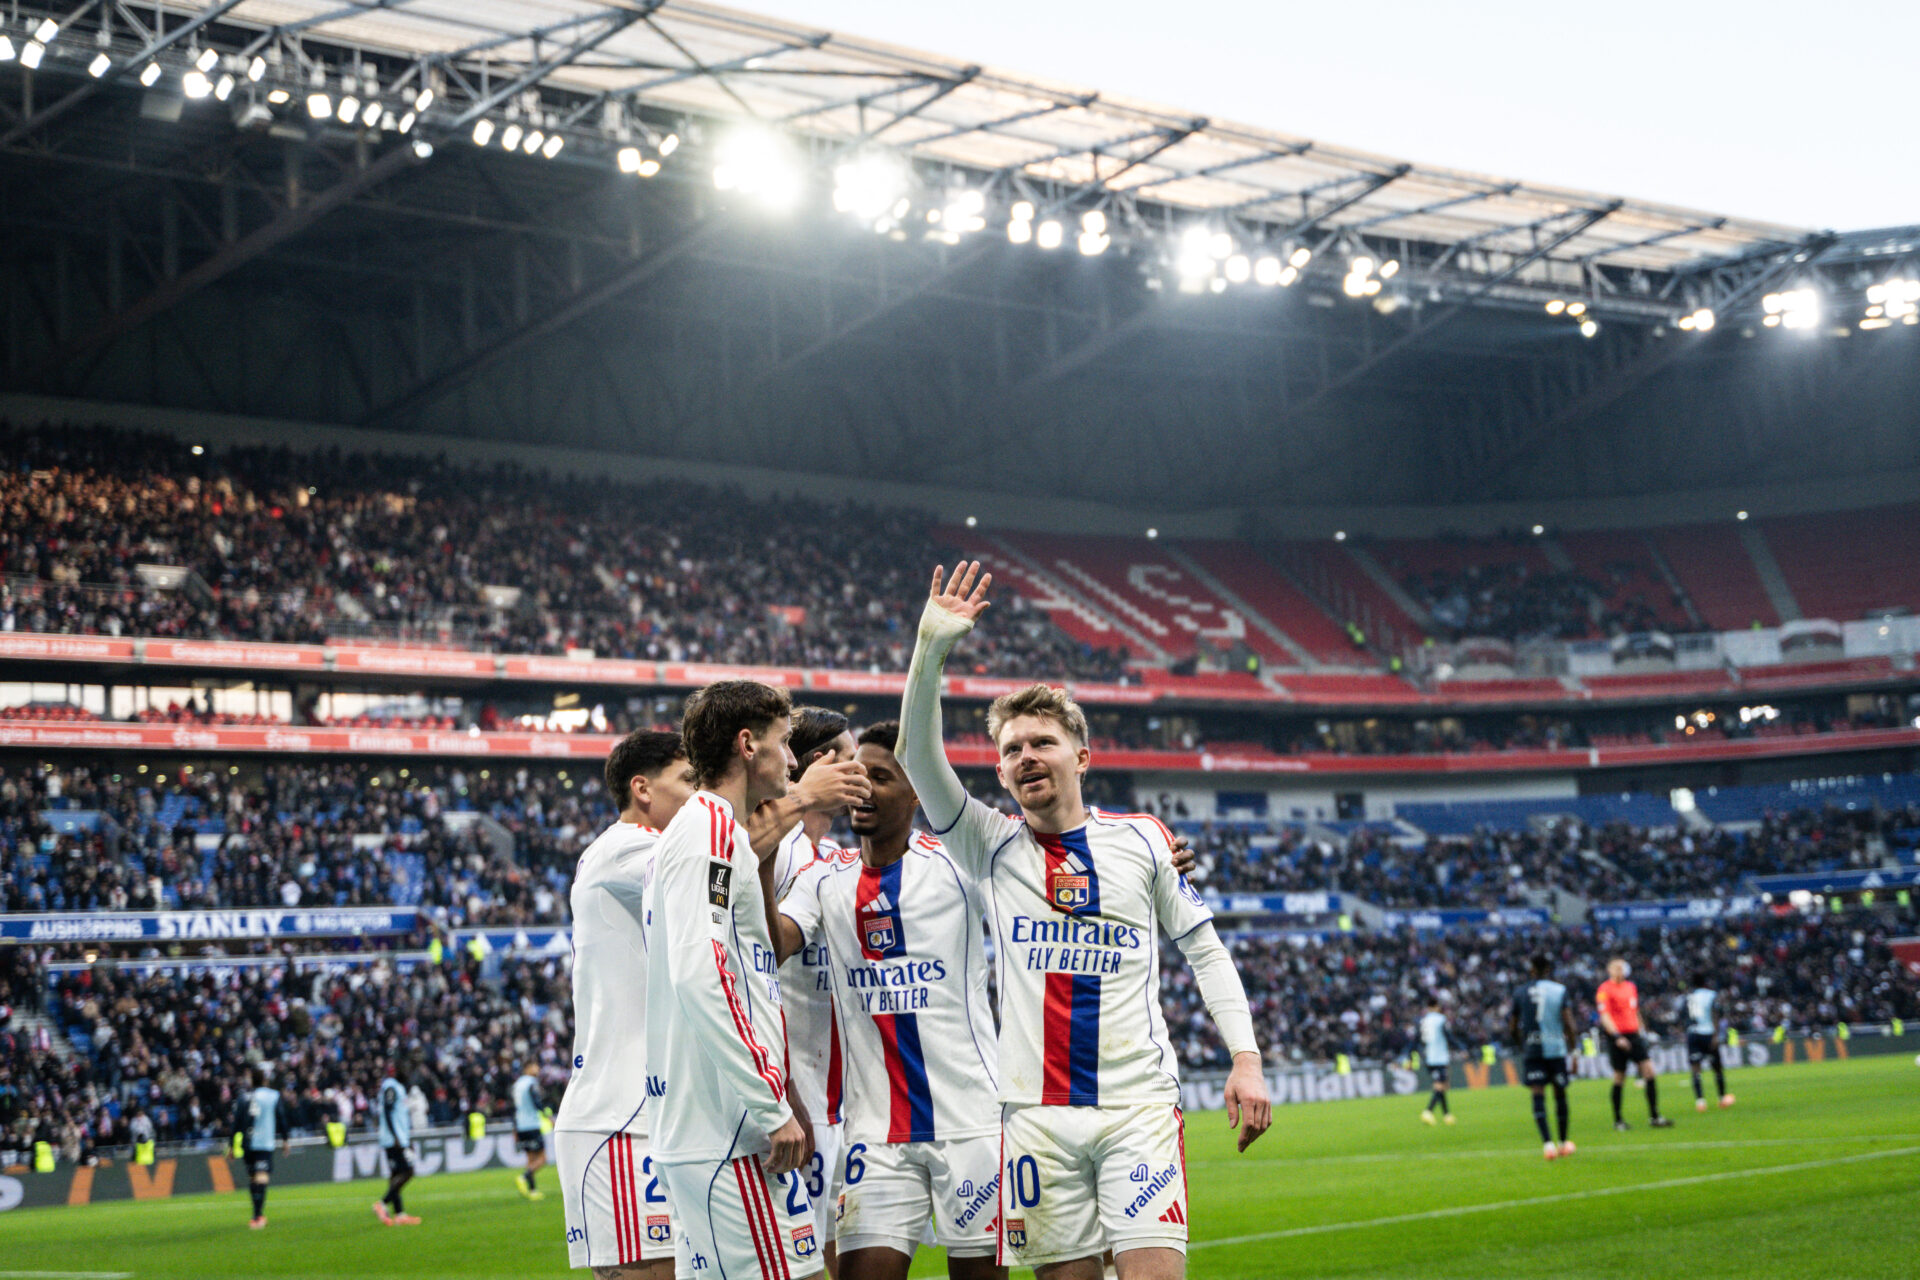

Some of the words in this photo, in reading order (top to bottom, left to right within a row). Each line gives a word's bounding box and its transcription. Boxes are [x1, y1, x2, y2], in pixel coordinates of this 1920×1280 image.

[1059, 888, 1085, 902] OL
[158, 912, 284, 939] STANLEY
[1012, 915, 1140, 949] Emirates
[1027, 947, 1054, 970] FLY
[1058, 948, 1122, 974] BETTER
[879, 987, 928, 1012] BETTER
[845, 1143, 867, 1185] 6
[1007, 1155, 1041, 1210] 10
[1125, 1163, 1178, 1218] trainline
